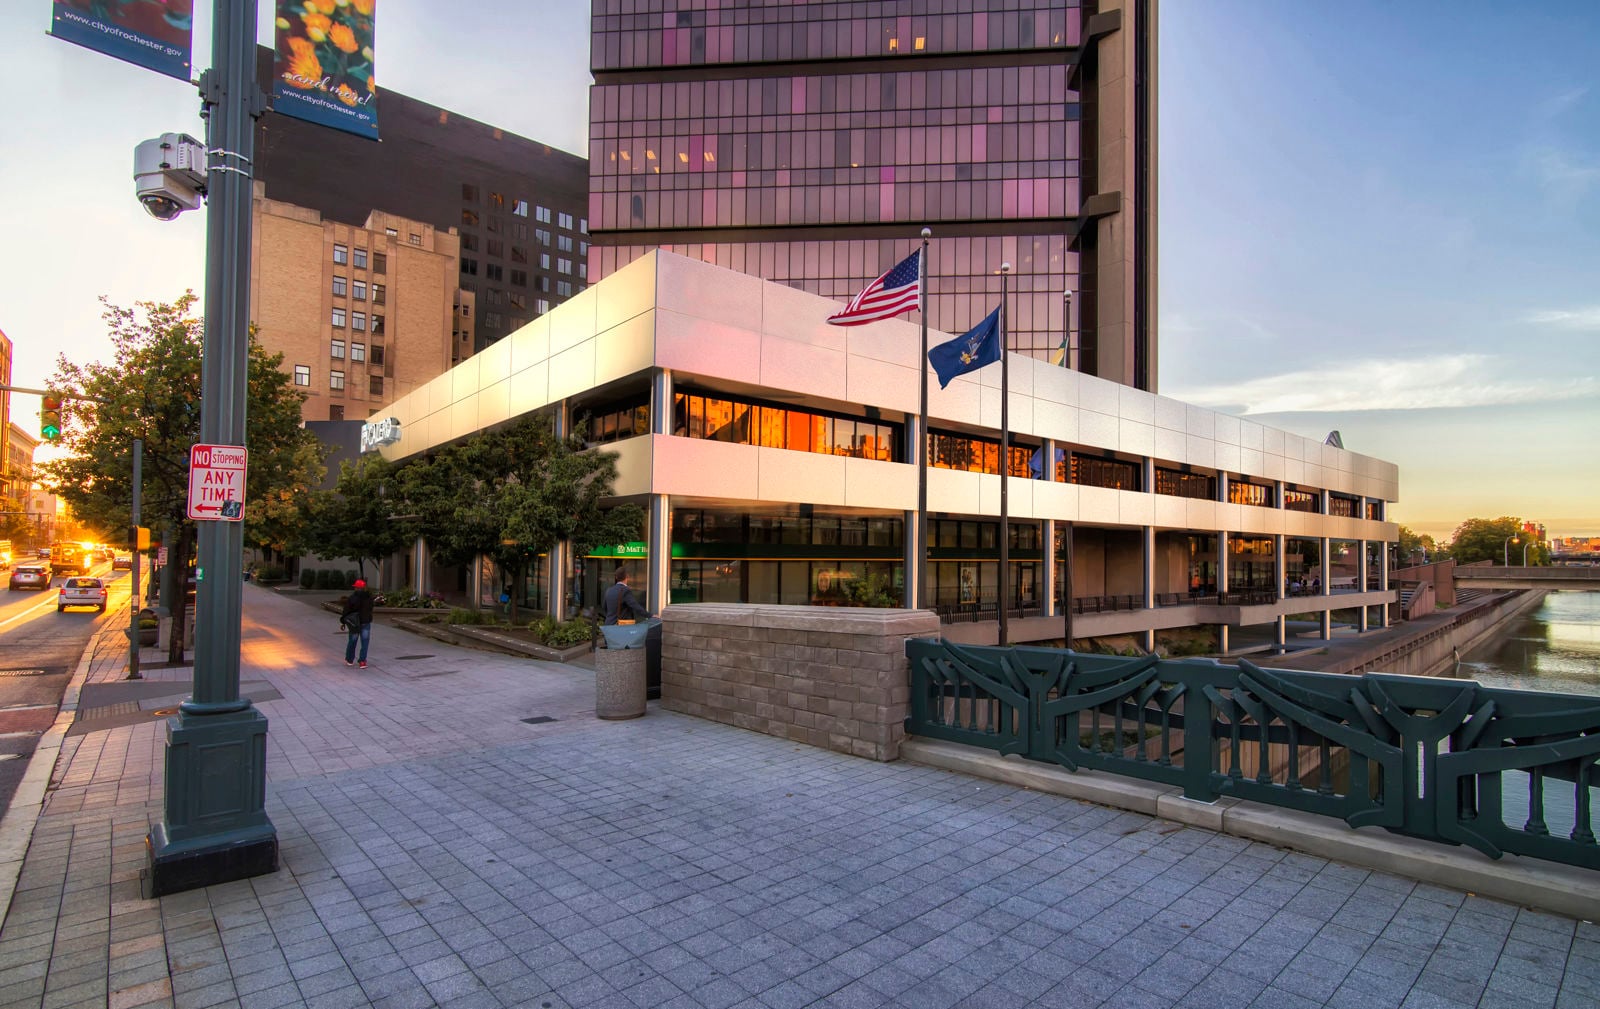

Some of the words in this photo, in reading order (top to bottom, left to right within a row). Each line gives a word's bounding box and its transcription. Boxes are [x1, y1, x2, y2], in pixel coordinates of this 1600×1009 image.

[64, 11, 182, 57] www.cityofrochester.gov
[329, 85, 373, 106] more!
[282, 89, 370, 121] www.cityofrochester.gov
[194, 451, 210, 465] NO
[212, 454, 244, 465] STOPPING
[204, 470, 235, 485] ANY
[201, 487, 236, 502] TIME
